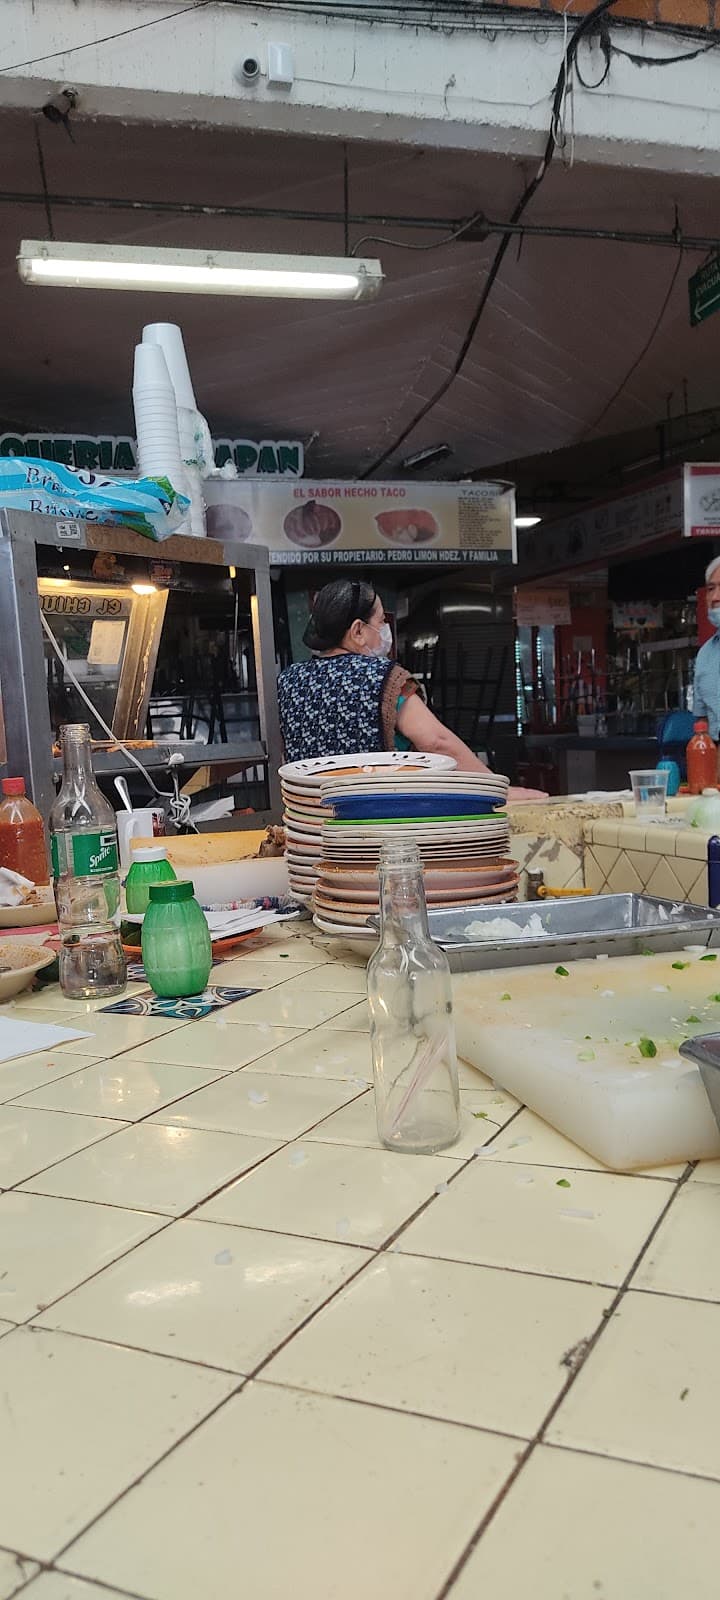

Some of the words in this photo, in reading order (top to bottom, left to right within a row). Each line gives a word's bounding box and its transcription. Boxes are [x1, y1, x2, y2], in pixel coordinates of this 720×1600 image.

[293, 488, 307, 498] EL
[308, 488, 341, 498] SABOR
[344, 487, 377, 498] HECHO
[381, 487, 406, 498] TACO
[269, 551, 301, 563] ENDIDO
[303, 551, 319, 563] POR
[320, 551, 332, 562] SU
[334, 551, 386, 562] PROPIETARIO:
[388, 551, 412, 561] PEDRO
[414, 550, 438, 561] LIMON
[462, 551, 468, 561] Y
[469, 550, 498, 561] FAMILIA
[89, 846, 111, 868] Sprite
